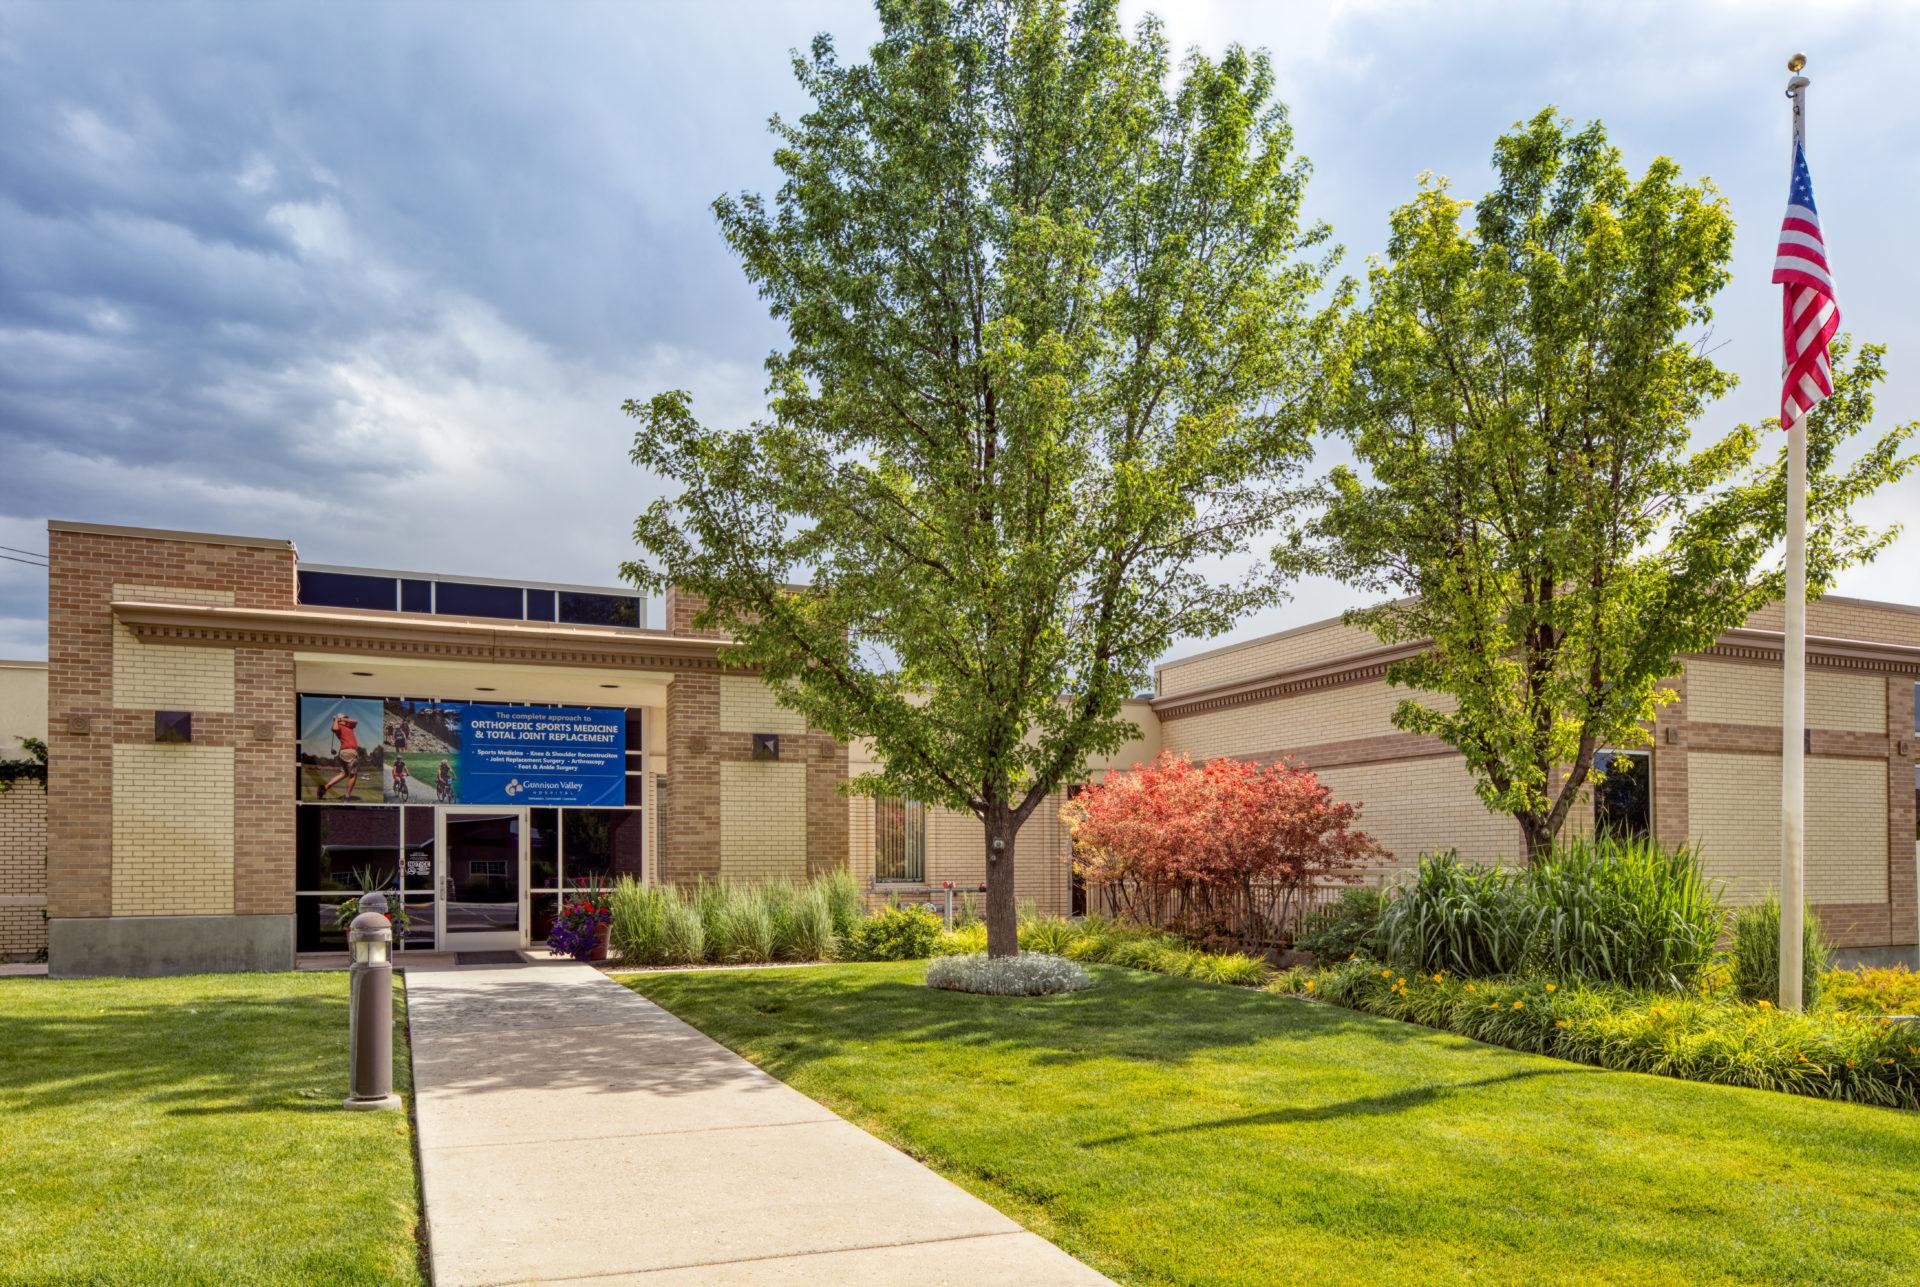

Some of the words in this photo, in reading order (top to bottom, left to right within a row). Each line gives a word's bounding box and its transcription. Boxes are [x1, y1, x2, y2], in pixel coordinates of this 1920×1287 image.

[512, 712, 546, 721] complete
[548, 714, 582, 722] approach
[471, 720, 534, 730] ORTHOPEDIC
[536, 723, 572, 732] SPORTS
[574, 724, 618, 734] MEDICINE
[475, 730, 484, 738] &
[486, 731, 516, 740] TOTAL
[518, 732, 546, 740] JOINT
[548, 733, 615, 742] REPLACEMENT
[523, 780, 559, 790] Gunnison
[560, 781, 583, 792] Valley
